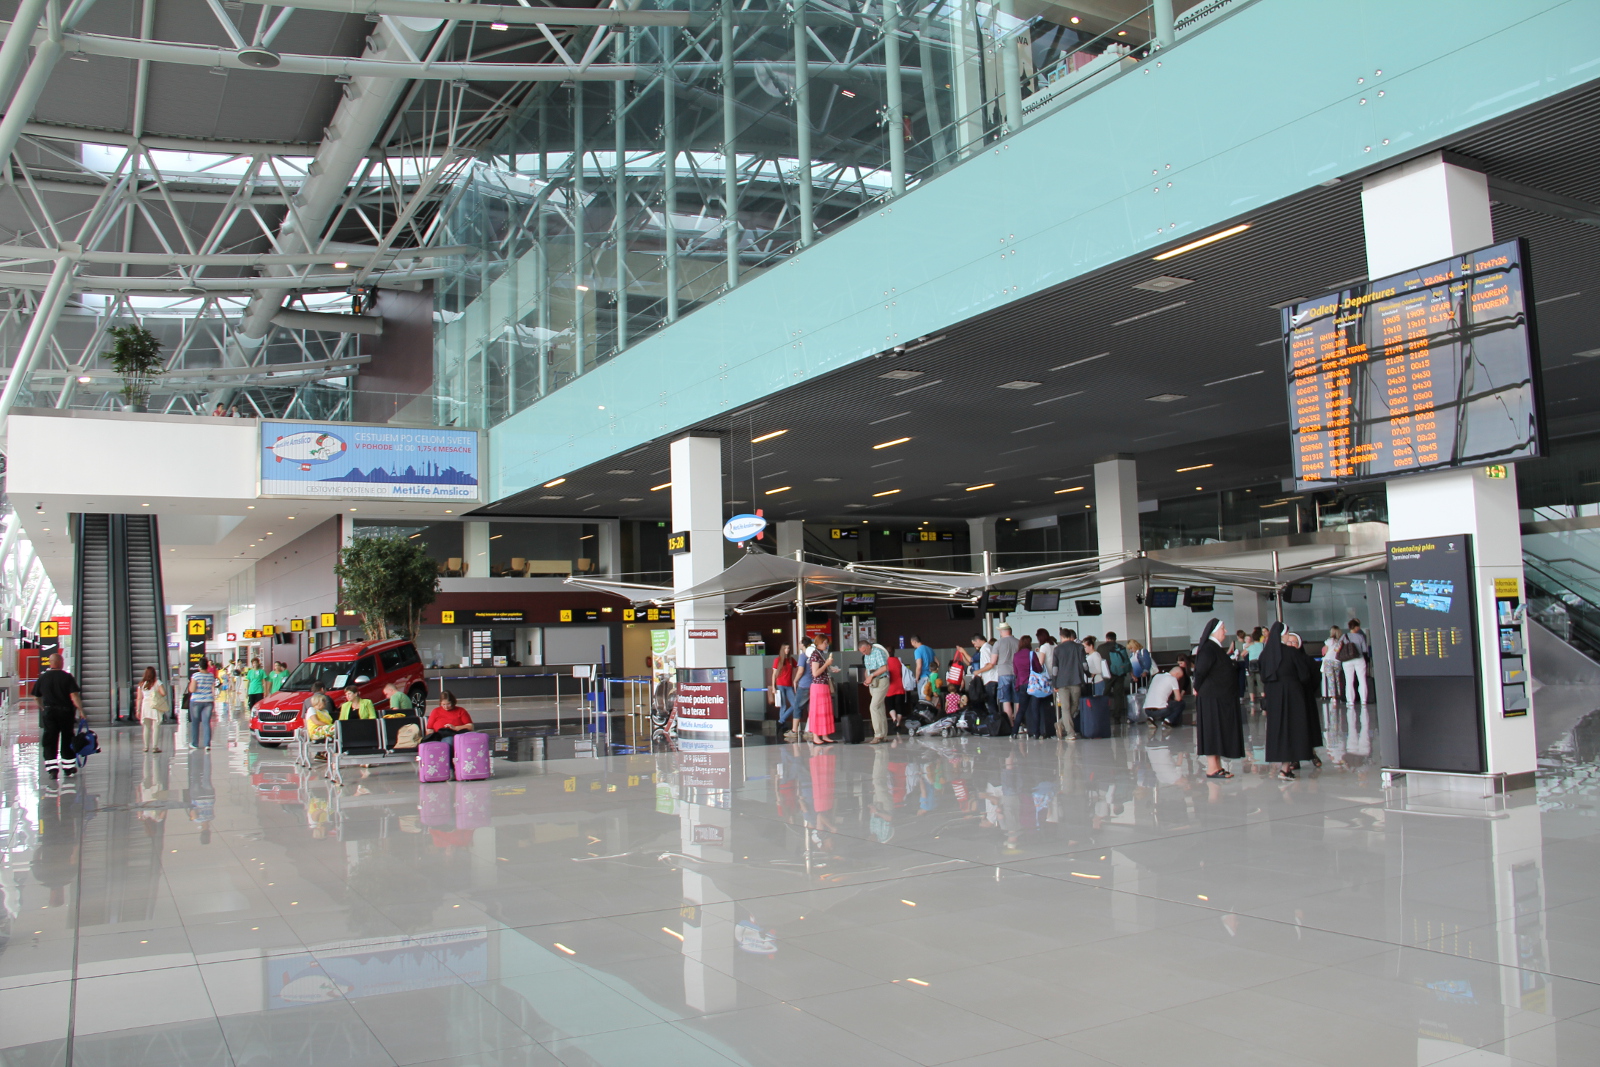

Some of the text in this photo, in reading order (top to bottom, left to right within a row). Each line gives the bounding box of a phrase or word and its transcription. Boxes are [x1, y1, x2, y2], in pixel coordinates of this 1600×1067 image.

[1475, 256, 1507, 271] 17:47:26
[1310, 304, 1338, 317] Odlety
[1345, 287, 1395, 308] Departures
[1382, 315, 1400, 326] 19:05
[1406, 308, 1425, 319] 19:05
[1383, 325, 1401, 335] 19:10
[1407, 318, 1426, 329] 19:10
[1347, 344, 1367, 355] TERME
[1384, 335, 1402, 346] 21:35
[1408, 329, 1427, 339] 21:35
[1384, 345, 1404, 356] 21:40
[1409, 339, 1428, 350] 21:40
[1385, 355, 1404, 366] 21:50
[1409, 349, 1429, 360] 21:50
[1324, 381, 1335, 389] TEL
[1386, 365, 1405, 376] 00:15
[1411, 360, 1430, 370] 00:15
[1325, 390, 1344, 399] CORFU
[1387, 375, 1406, 386] 04:30
[1412, 370, 1431, 380] 04:30
[1388, 385, 1407, 396] 04:30
[1412, 380, 1432, 390] 04:30
[1389, 396, 1408, 406] 05:00
[1413, 391, 1433, 401] 05:00
[1390, 406, 1409, 416] 06:45
[1414, 401, 1434, 411] 06:45
[1390, 416, 1410, 426] 07:20
[1415, 411, 1435, 421] 07:20
[1391, 426, 1410, 436] 07:20
[1416, 422, 1435, 432] 07:20
[290, 437, 311, 446] Amslico
[354, 433, 471, 445] CESTUJEM PO CELOM SVETE
[1392, 437, 1411, 446] 08:20
[1417, 432, 1436, 442] 08:20
[1393, 447, 1412, 457] 08:45
[1418, 443, 1437, 452] 08:45
[1394, 457, 1413, 467] 09:55
[1419, 453, 1438, 463] 09:55
[343, 486, 374, 494] POISTENIE
[392, 486, 431, 495] MetLife
[432, 486, 469, 496] Amslico
[669, 535, 684, 550] 15-28
[1391, 544, 1421, 554] Orientačný
[1422, 543, 1435, 552] plán
[693, 695, 724, 705] poistenie
[691, 707, 706, 716] teraz
